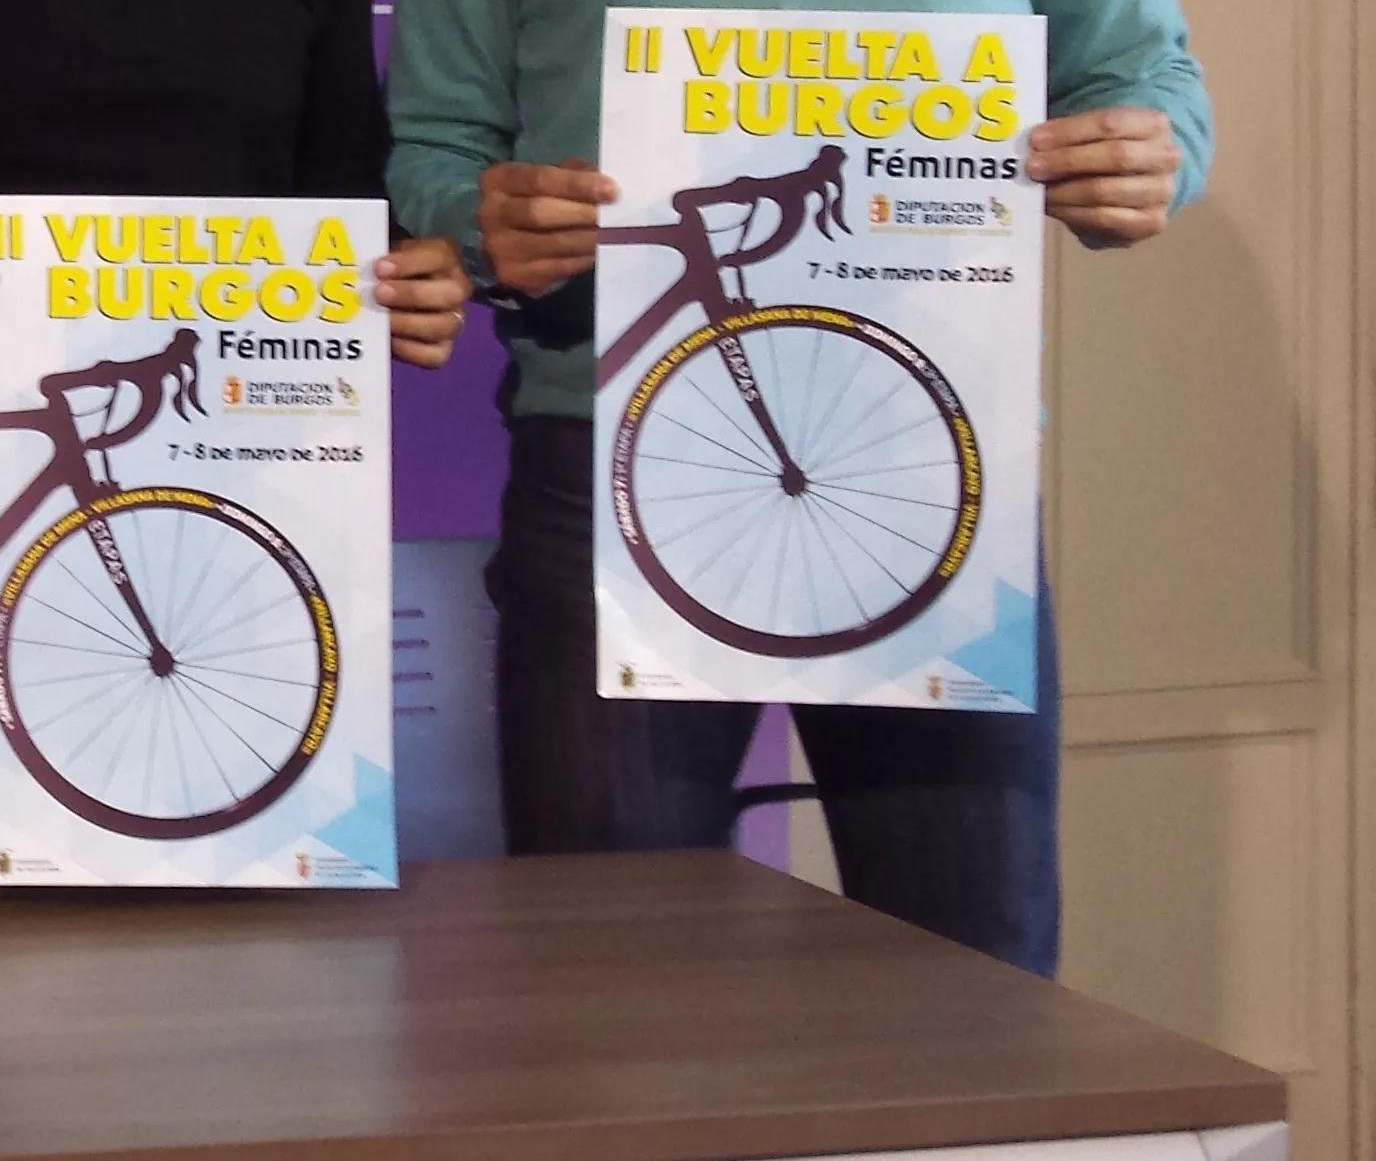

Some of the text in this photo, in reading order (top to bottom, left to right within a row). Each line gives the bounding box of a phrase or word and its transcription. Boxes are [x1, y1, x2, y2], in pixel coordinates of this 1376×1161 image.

[625, 26, 1015, 84] II VUELTA A
[684, 81, 1020, 142] BURGOS
[866, 148, 1017, 180] Féminas
[897, 213, 984, 226] DE BURGOS
[44, 214, 284, 265] VUELTA
[305, 216, 356, 266] A
[965, 267, 1014, 283] 2016
[47, 265, 361, 323] BURGOS
[219, 330, 363, 361] Féminas
[249, 393, 333, 406] DE BURGOS
[318, 445, 364, 463] 2016
